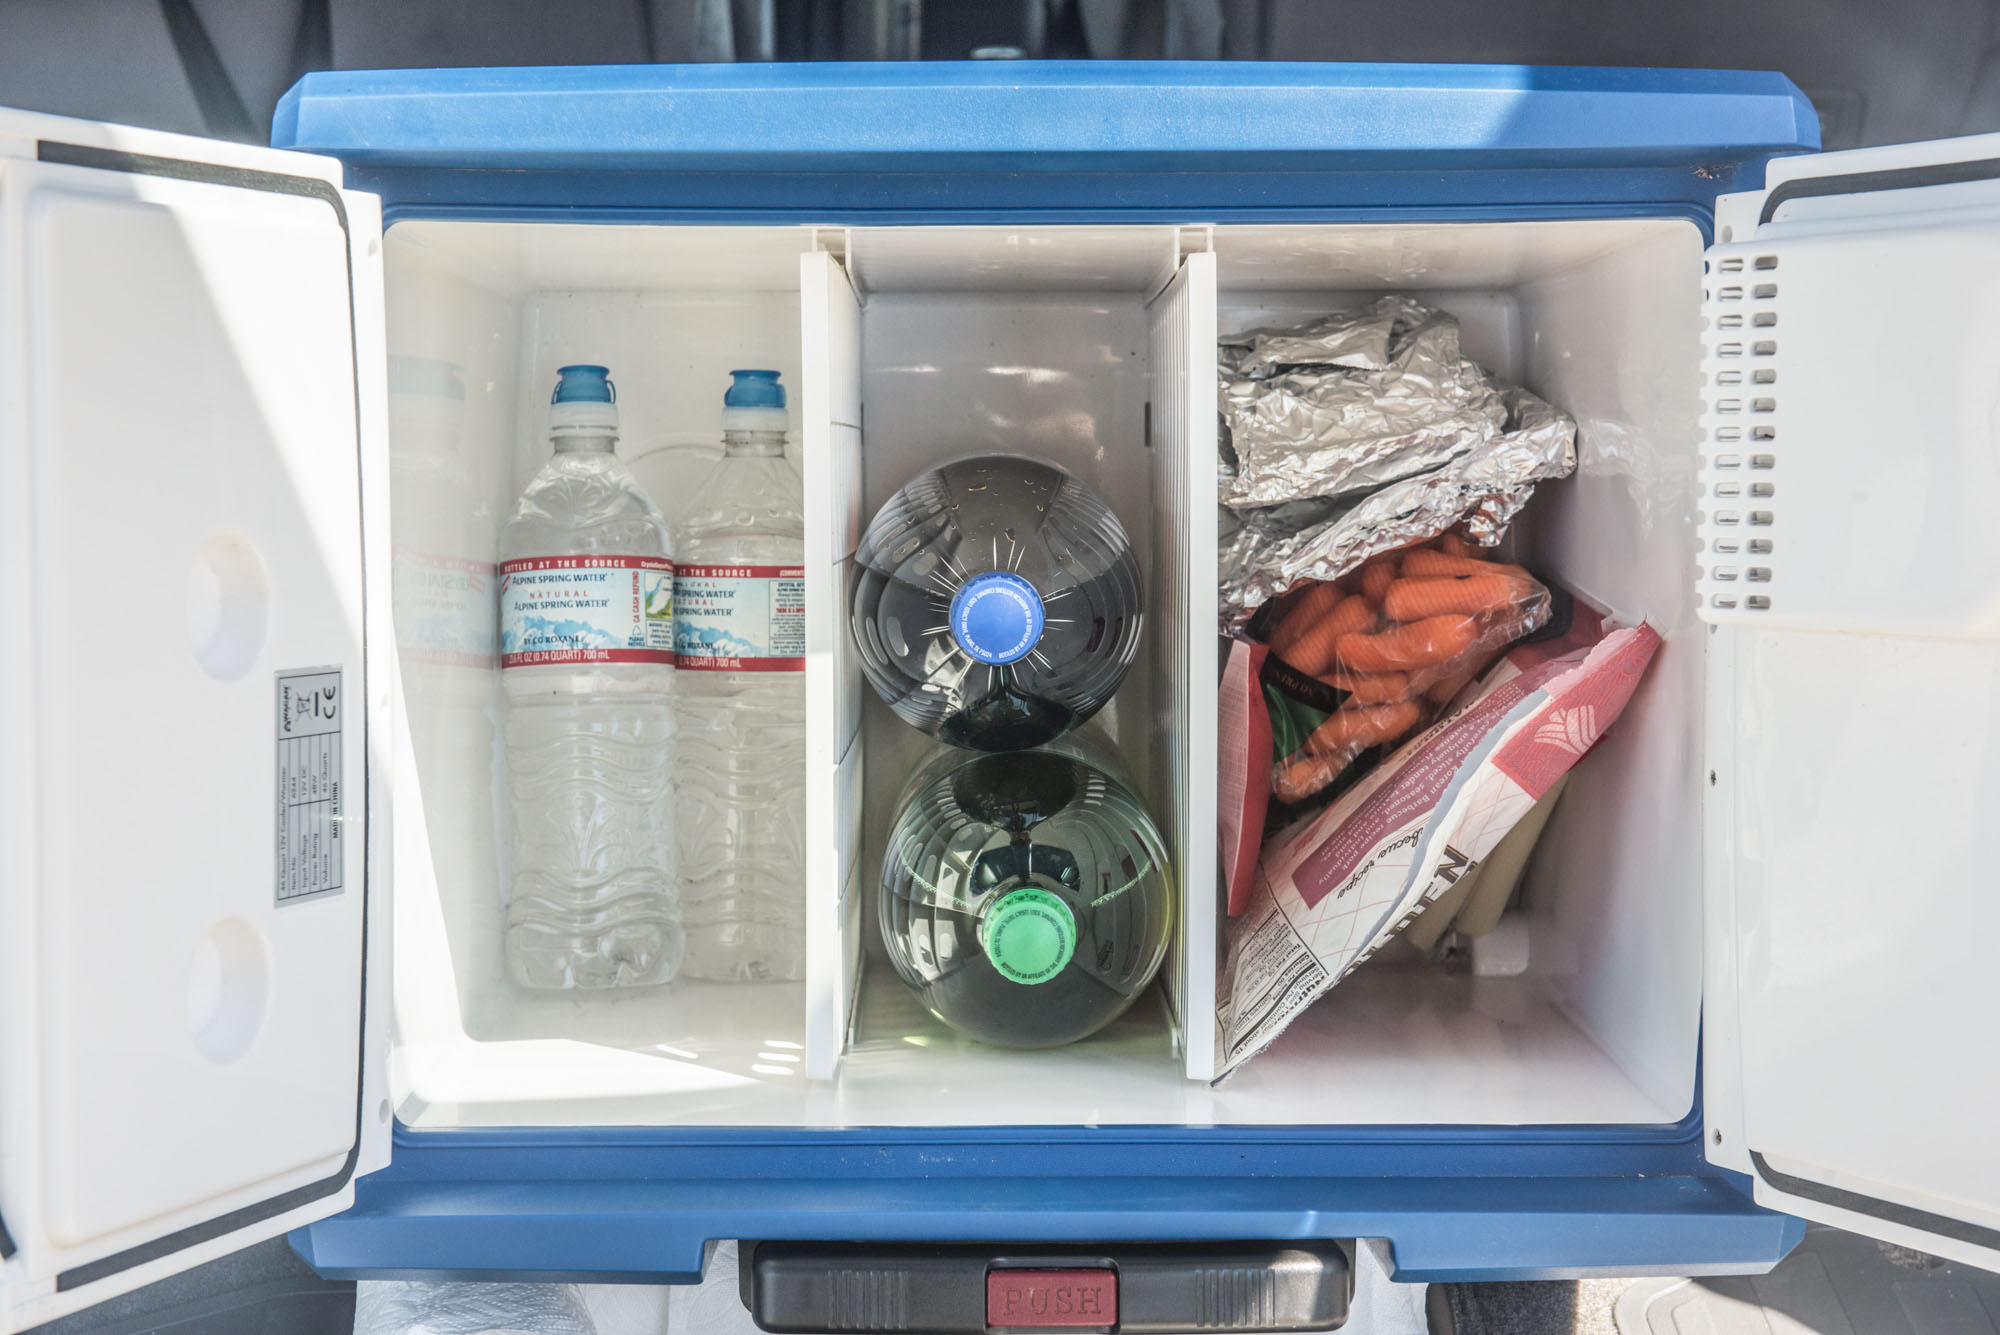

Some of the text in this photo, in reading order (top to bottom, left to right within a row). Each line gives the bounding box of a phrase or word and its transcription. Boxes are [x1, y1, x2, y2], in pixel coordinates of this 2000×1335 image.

[505, 562, 533, 572] BOTTLED
[584, 560, 625, 568] SOURCE
[712, 569, 752, 577] SOURCE
[512, 572, 607, 585] ALPINE SPRING WATER
[530, 590, 588, 599] NATURAL
[514, 600, 608, 611] ALPINE SPRING WATER
[633, 614, 640, 622] CA
[524, 654, 532, 662] OZ
[550, 650, 581, 660] QUART)
[584, 650, 596, 660] 700
[598, 650, 611, 659] mL
[690, 657, 714, 666] QUART)
[716, 658, 728, 667] 700
[730, 658, 742, 667] mL
[1428, 731, 1469, 766] uniquely
[1453, 719, 1491, 759] carefully
[1399, 764, 1430, 790] tender
[1424, 756, 1453, 783] sliced,
[1380, 782, 1425, 816] seasoned,
[1339, 763, 1458, 871] Korean Barbecue recipe pork
[1338, 860, 1375, 898] recipe
[1284, 942, 1301, 958] Total
[1275, 957, 1286, 968] Fat
[1283, 953, 1310, 977] Calories
[1292, 965, 1319, 990] Servings
[1248, 992, 1273, 1017] Calories
[1259, 1002, 1286, 1030] Container
[1242, 1029, 1260, 1047] about
[1234, 1046, 1243, 1055] 15
[1002, 1287, 1102, 1316] PUSH
